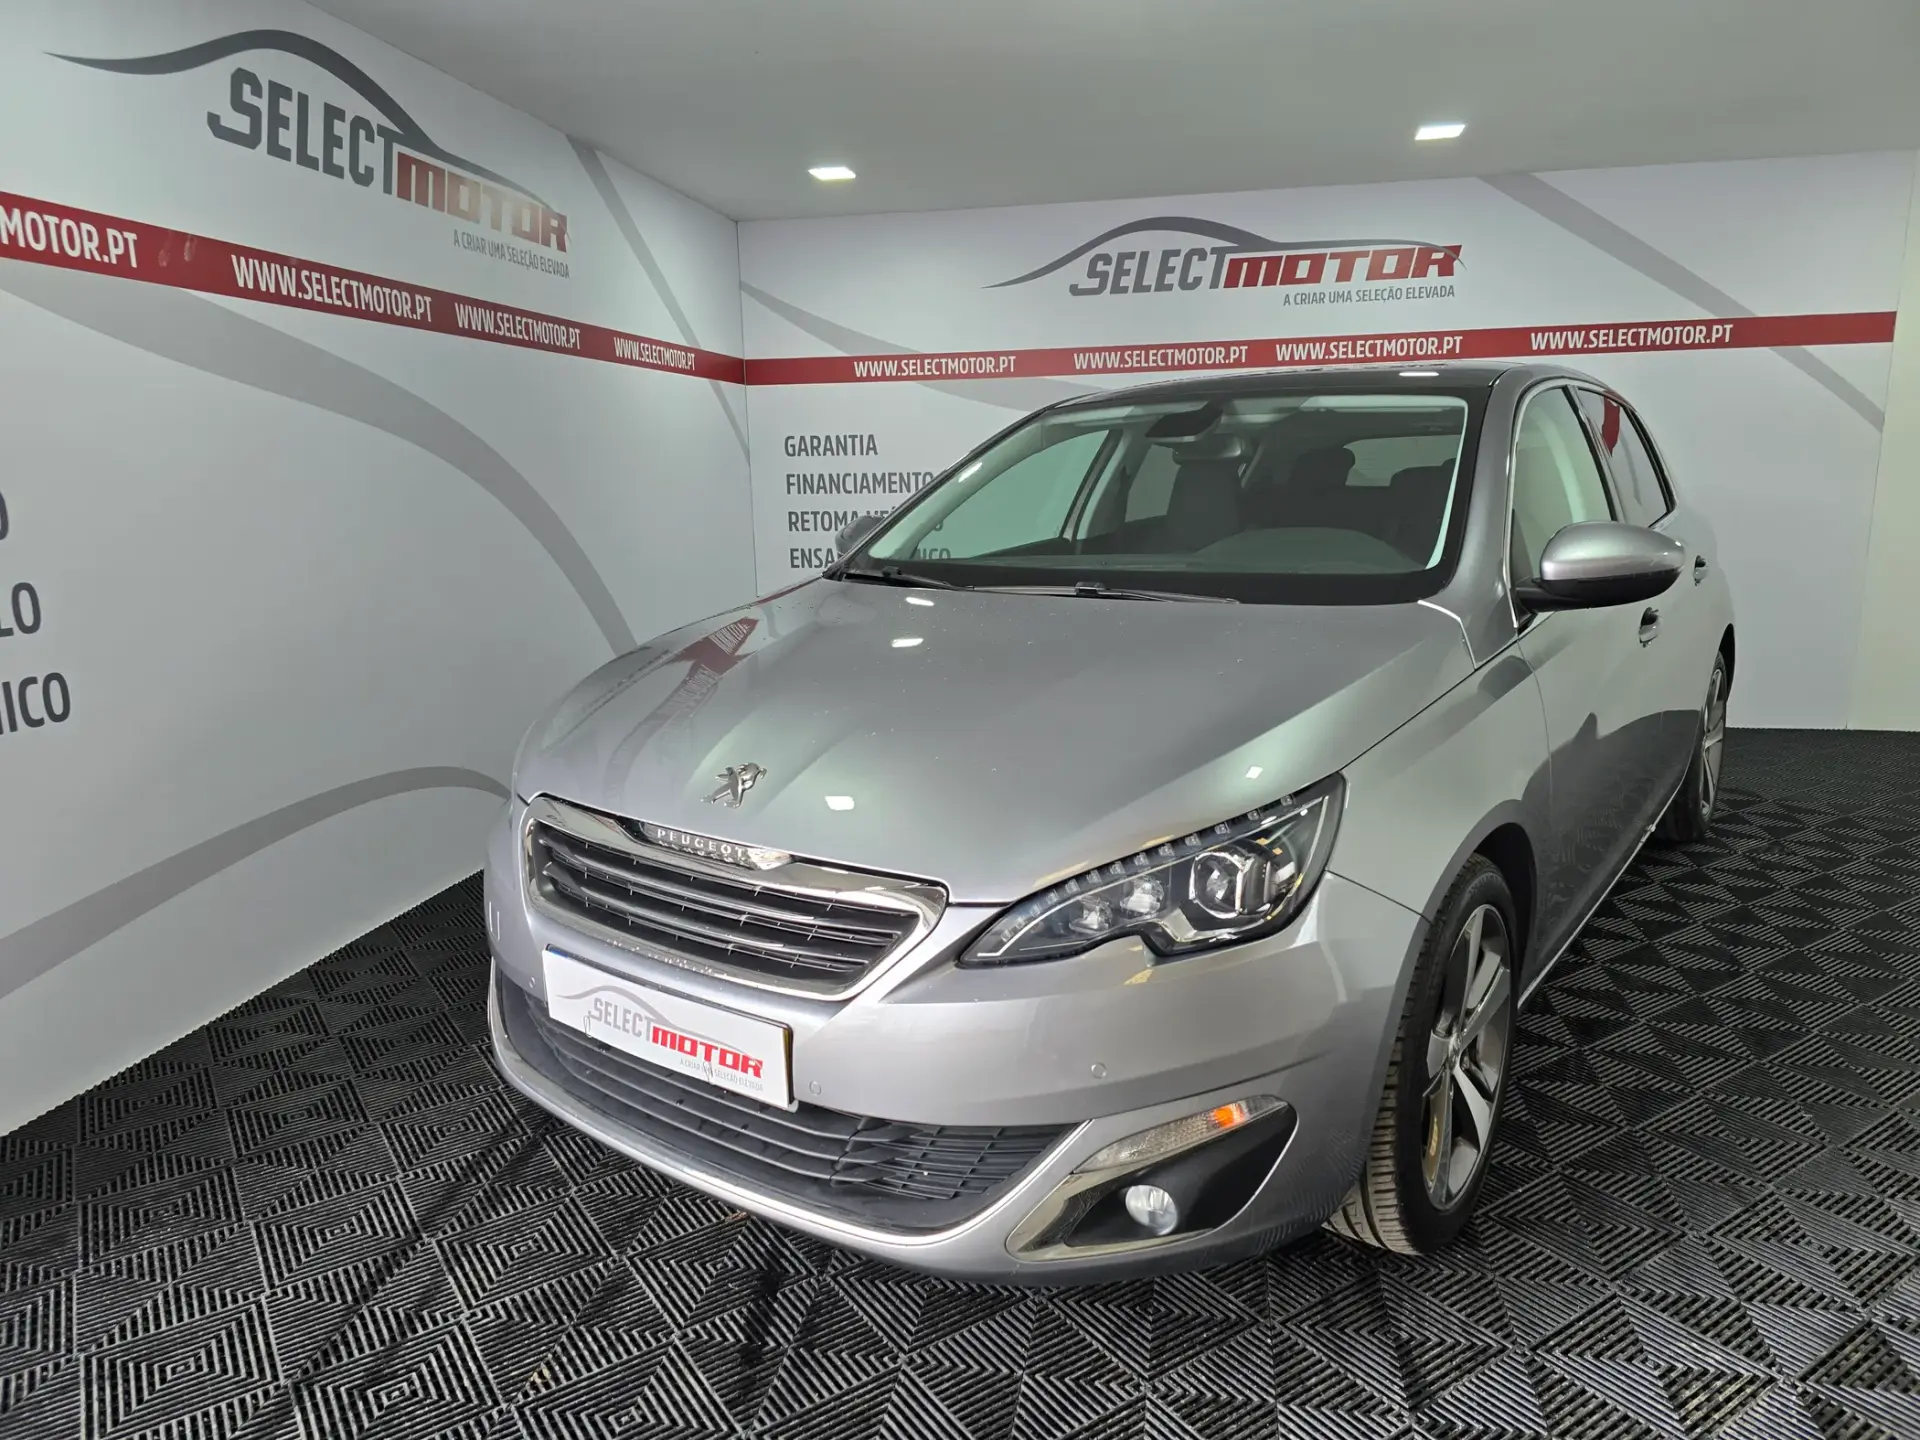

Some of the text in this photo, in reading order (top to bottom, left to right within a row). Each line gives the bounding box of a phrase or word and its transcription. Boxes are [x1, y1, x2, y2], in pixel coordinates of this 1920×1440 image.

[453, 229, 460, 247] A
[462, 232, 487, 255] CRIAR
[488, 240, 506, 261] UMA
[540, 256, 570, 279] ELEVADA
[231, 254, 432, 323] WWW.SELECTMOTOR.PT
[454, 302, 581, 350] WWW.SELECTMOTOR.PT
[613, 336, 696, 371] WWW.SELECTMOTOR.PT
[1283, 284, 1456, 306] A CRIAR UMA SELEÇÃO ELEVADA
[853, 324, 1734, 378] WWW.SELECTMOTOR.PT WWW.SELECTMOTOR.PT WWW.SELECTMOTOR.PT WWW.SELECTMOTOR.PT
[784, 433, 879, 457] GARANTIA
[0, 672, 71, 735] ICO
[657, 828, 745, 857] PEUGEOT
